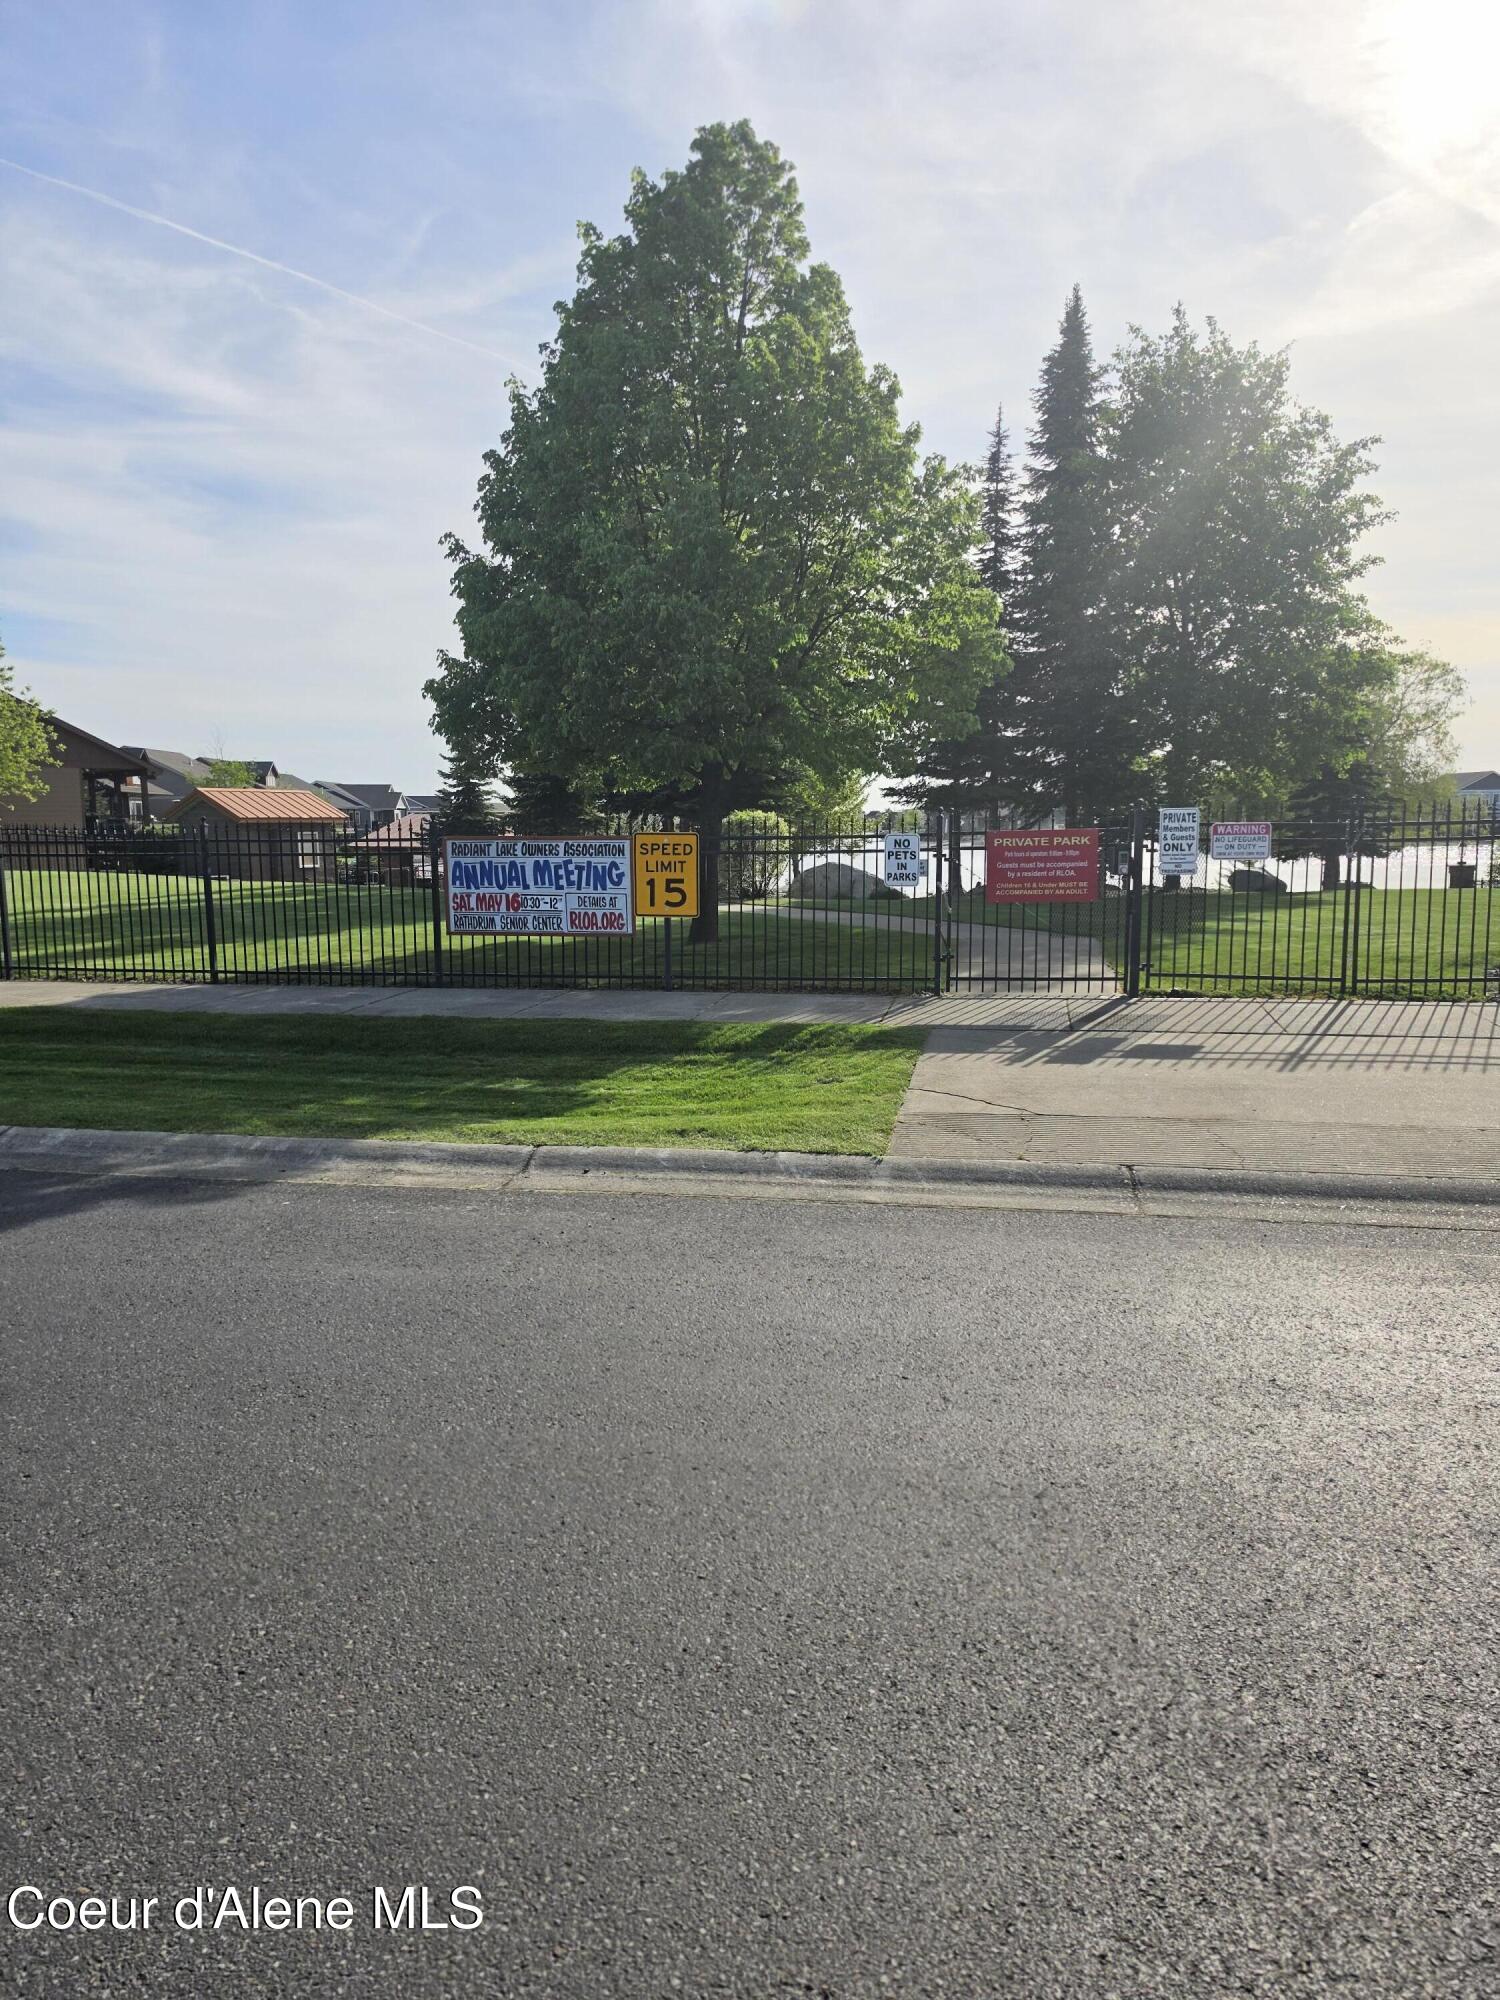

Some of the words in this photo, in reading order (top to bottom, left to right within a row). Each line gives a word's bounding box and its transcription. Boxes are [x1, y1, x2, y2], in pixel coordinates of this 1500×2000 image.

[1163, 813, 1196, 823] PRIVATE
[1217, 824, 1266, 834] WARNING
[894, 839, 910, 848] NO
[994, 837, 1049, 847] PRIVATE
[1054, 836, 1090, 846] PARK
[1164, 842, 1193, 852] ONLY
[452, 842, 492, 856] RADIANT
[496, 842, 518, 856] LAKE
[522, 842, 560, 856] OWNERS
[564, 842, 625, 856] ASSOCIATION
[640, 843, 693, 856] SPEED
[888, 851, 916, 860] PETS
[646, 860, 686, 872] LIMIT
[897, 862, 907, 870] IN
[1046, 860, 1088, 869] accompanied
[452, 860, 530, 890] ANNUAL
[533, 859, 625, 891] MEETING
[887, 873, 917, 881] PARKS
[646, 878, 687, 908] 15
[476, 892, 502, 911] MAY
[506, 892, 521, 912] 16
[578, 896, 606, 907] DETAILS
[609, 897, 618, 907] AT
[454, 914, 496, 929] RATHDRUM
[500, 915, 530, 930] SENIOR
[532, 916, 563, 930] CENTER
[569, 911, 625, 930] RLOA.ORG
